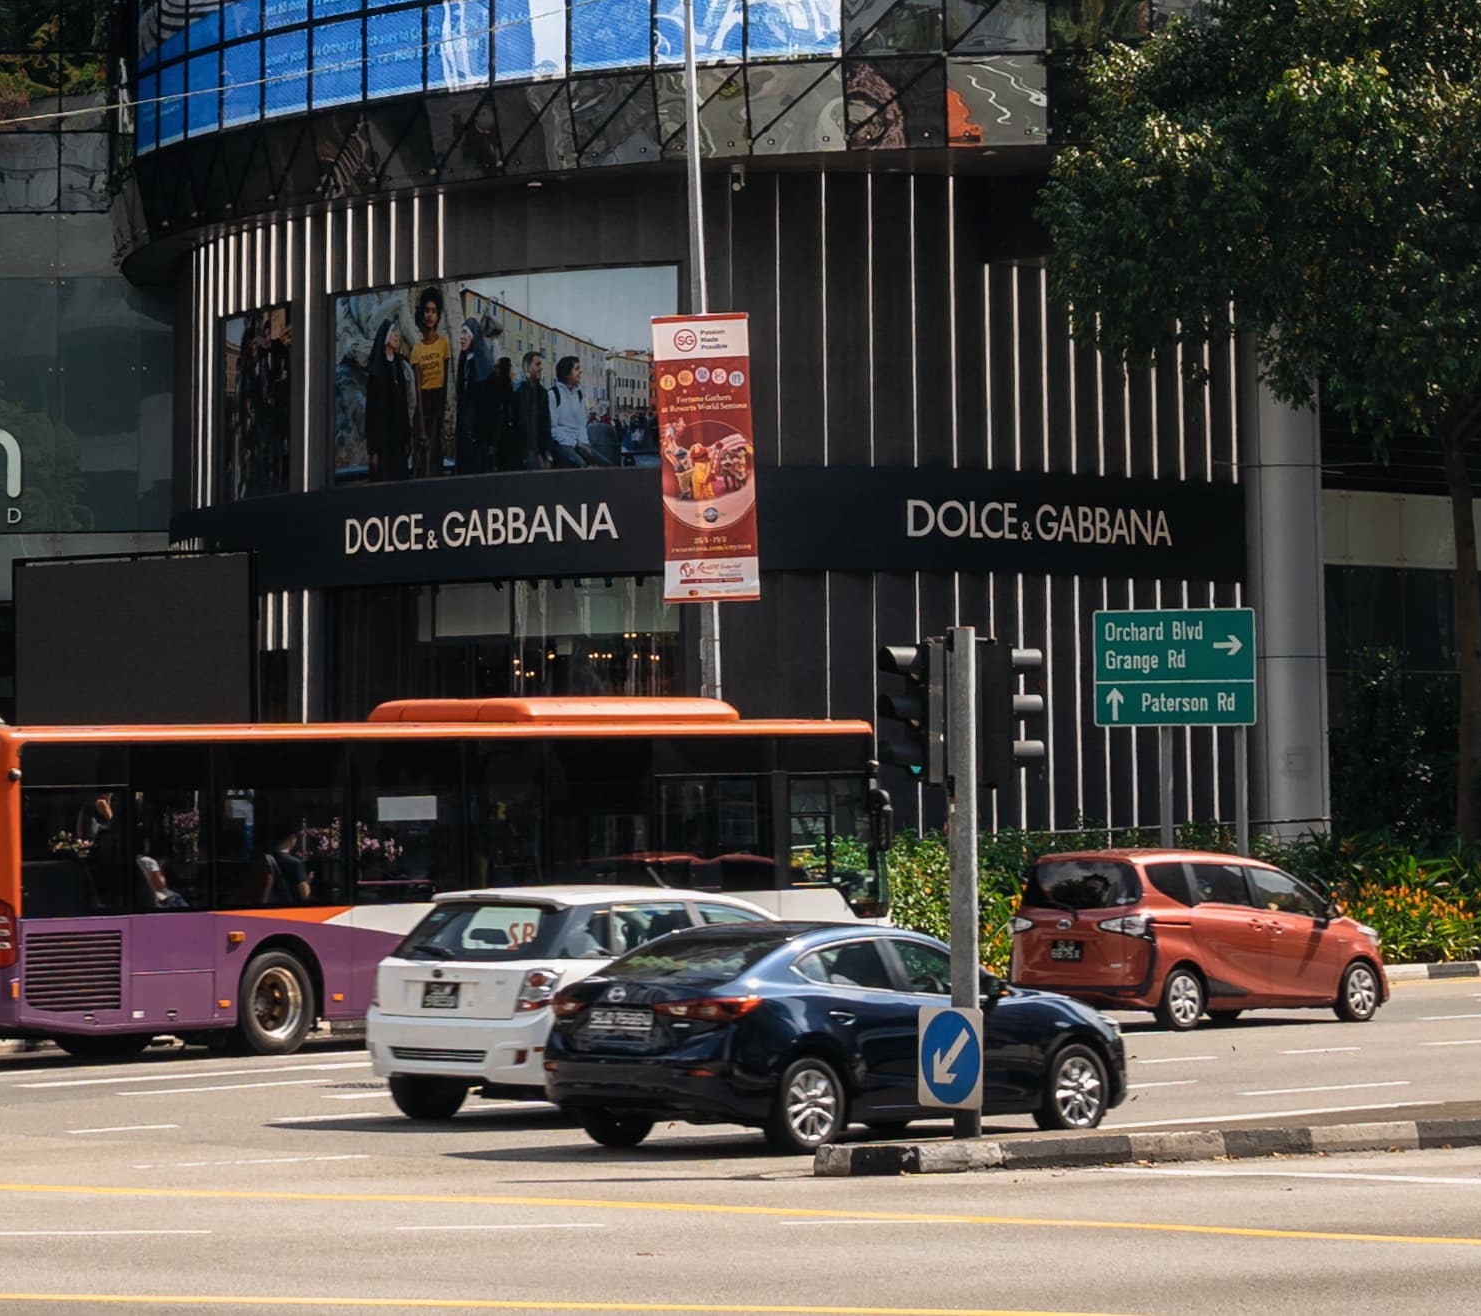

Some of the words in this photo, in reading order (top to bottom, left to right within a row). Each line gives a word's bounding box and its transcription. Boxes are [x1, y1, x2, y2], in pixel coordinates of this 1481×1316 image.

[678, 335, 694, 345] SG
[345, 513, 424, 554] DOLCE
[426, 529, 439, 550] &
[442, 502, 619, 547] GABBANA
[907, 499, 1018, 539] DOLCE
[1021, 520, 1033, 541] &
[1036, 503, 1173, 546] GABBANA
[1105, 621, 1164, 641] Orchard
[1172, 620, 1204, 640] Blvd
[1105, 650, 1159, 674] Grange
[1167, 649, 1186, 669] Rd
[1141, 692, 1208, 712] Paterson
[1217, 692, 1236, 712] Rd
